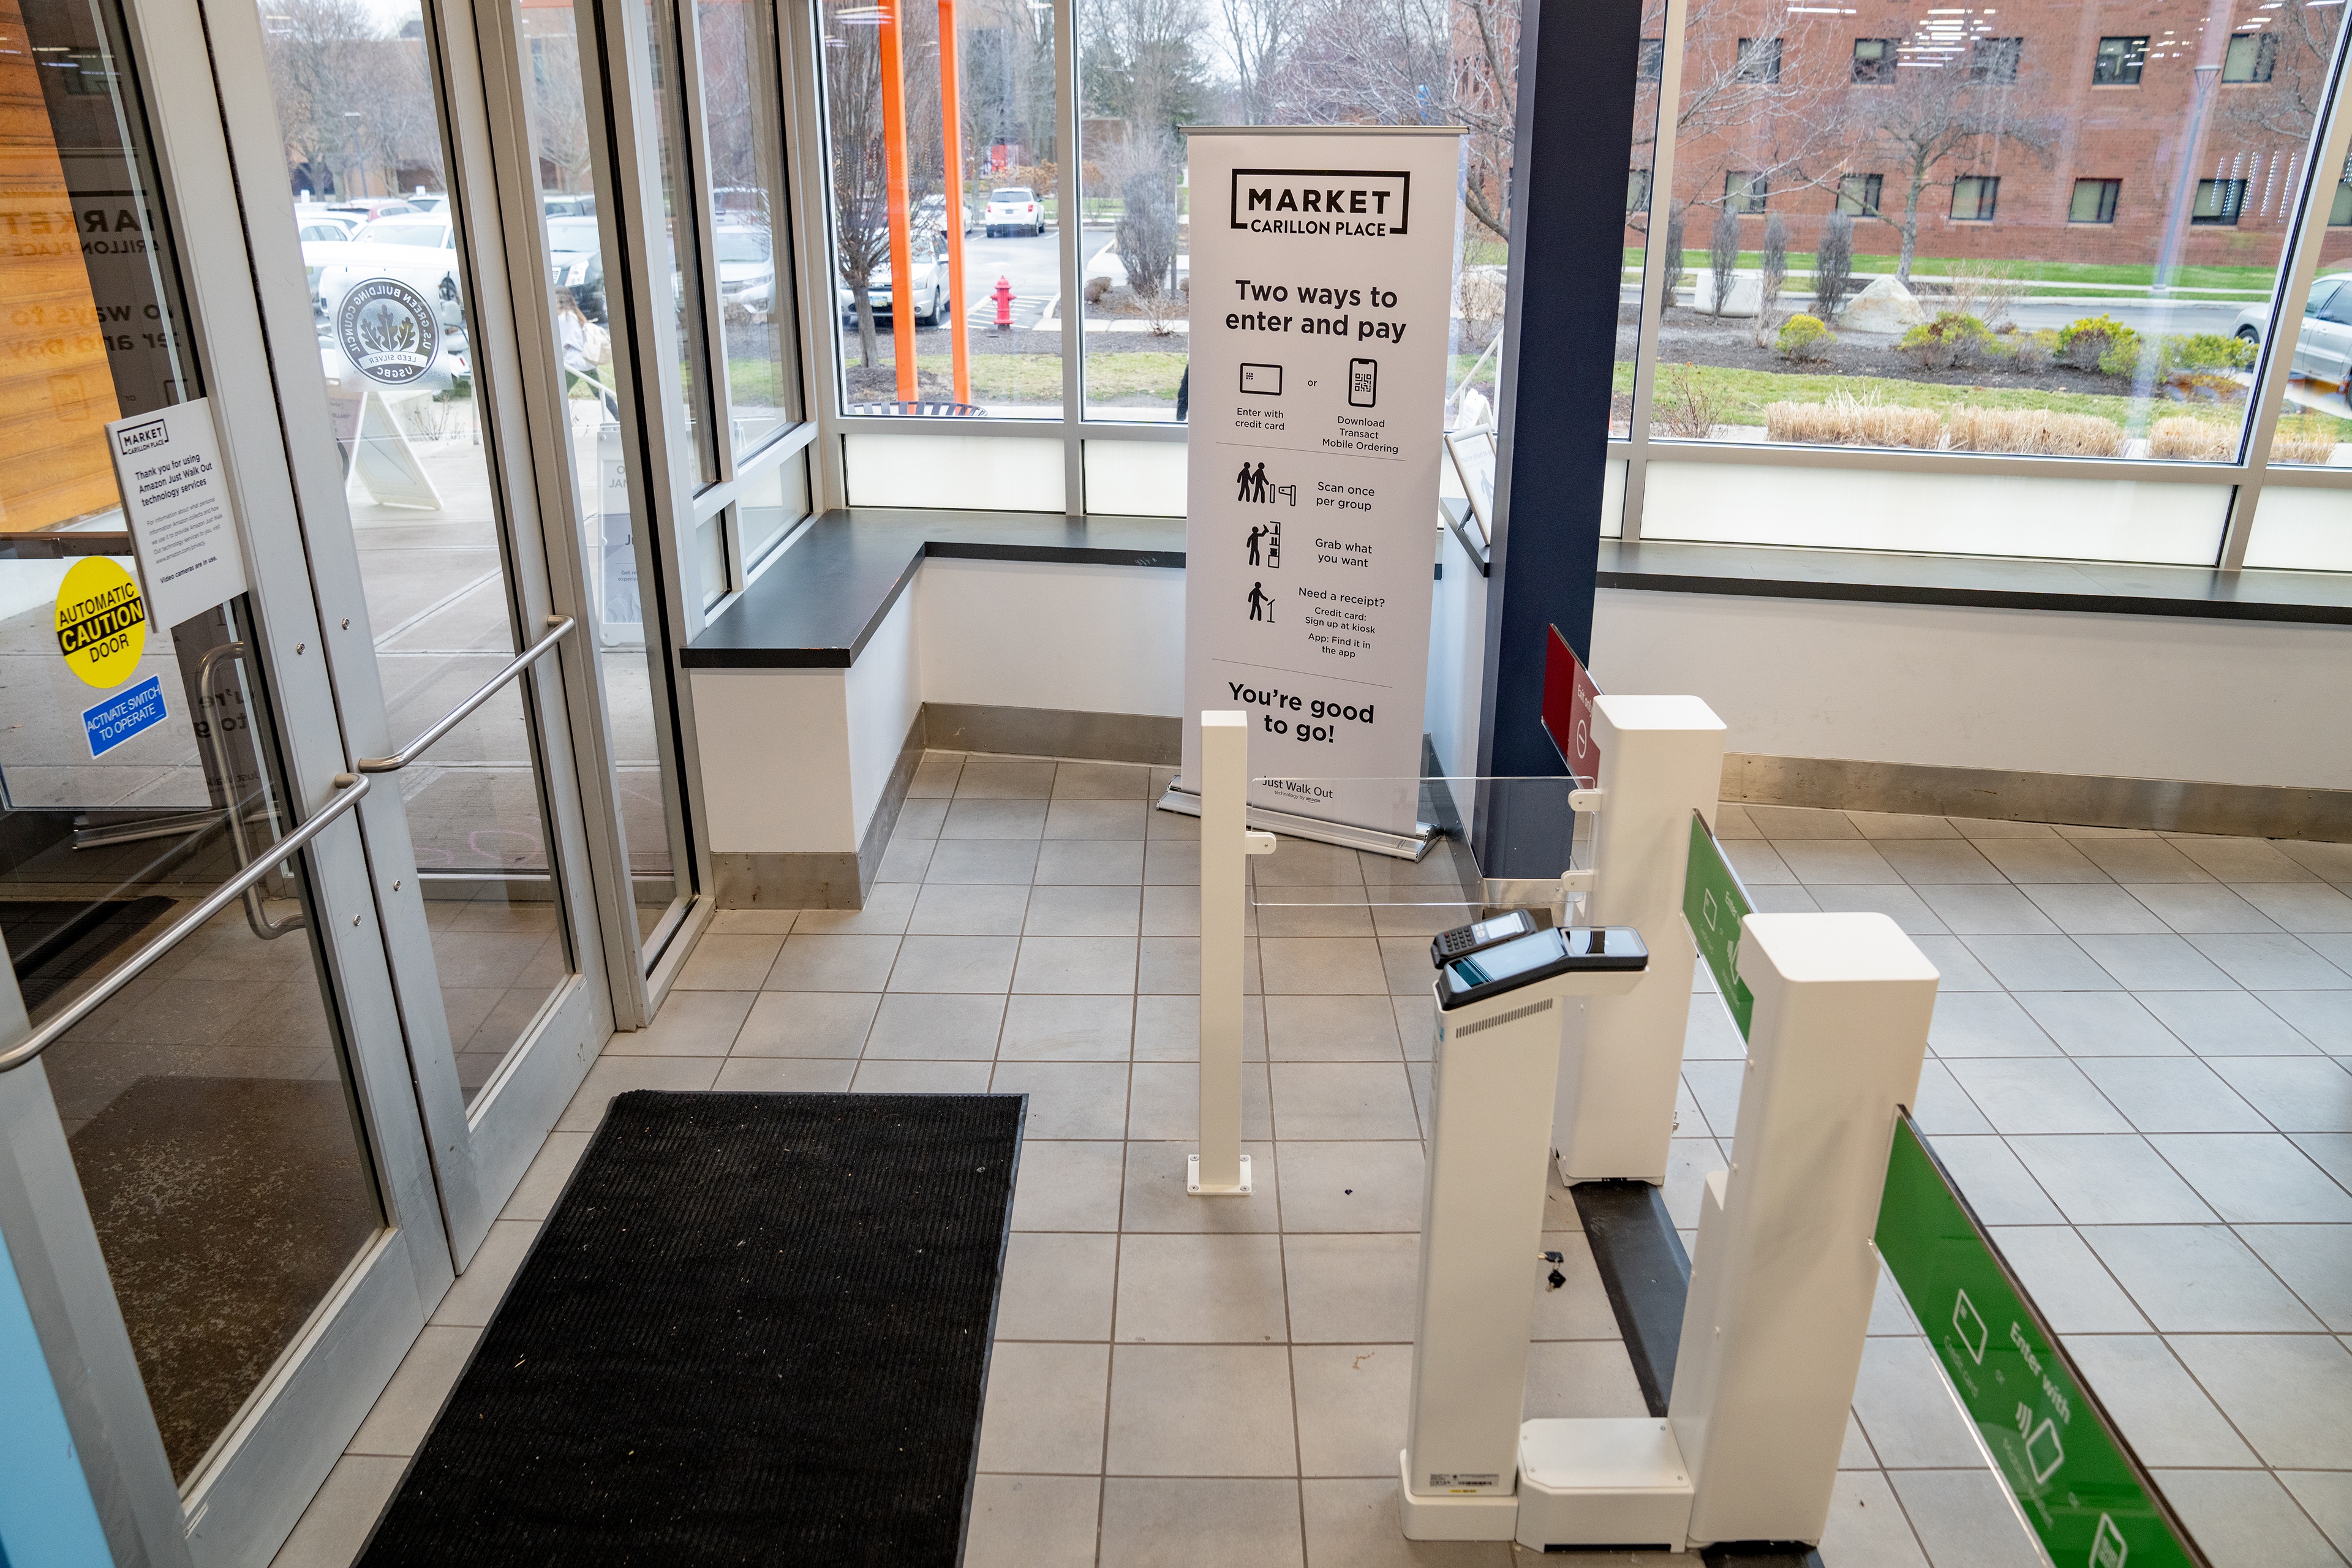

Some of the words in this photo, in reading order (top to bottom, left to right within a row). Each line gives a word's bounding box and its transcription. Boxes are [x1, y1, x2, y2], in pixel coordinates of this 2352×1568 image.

[1248, 188, 1390, 214] MARKET
[1251, 219, 1330, 235] CARILLON
[1335, 222, 1386, 237] PLACE
[1235, 279, 1288, 302] Two
[1297, 287, 1361, 310] ways
[1370, 287, 1398, 308] to
[1226, 311, 1293, 333] enter
[1301, 314, 1349, 336] and
[1358, 320, 1407, 344] pay
[1237, 407, 1262, 417] Enter
[1264, 409, 1284, 418] with
[1337, 416, 1385, 428] Download
[1235, 419, 1262, 429] credit
[1264, 422, 1285, 431] card
[1340, 428, 1379, 439] Transact
[124, 427, 162, 447] MARKET
[1322, 438, 1353, 449] Mobile
[1355, 442, 1399, 454] Ordering
[128, 443, 151, 455] CARILLON
[151, 439, 165, 448] PLACE
[135, 469, 157, 481] Thank
[158, 463, 170, 475] you
[172, 459, 181, 469] for
[183, 454, 200, 466] using
[140, 479, 167, 494] Amazon
[168, 473, 182, 484] Just
[183, 467, 200, 479] Walk
[200, 462, 213, 472] Out
[141, 486, 179, 507] technology
[181, 478, 206, 493] services
[1317, 481, 1344, 493] Scan
[1348, 486, 1375, 497] once
[155, 511, 178, 523] information
[200, 497, 216, 507] personal
[1316, 497, 1335, 507] per
[1338, 500, 1371, 512] group
[149, 524, 172, 536] information
[173, 517, 188, 526] Amazon
[190, 521, 205, 530] Amazon
[162, 540, 184, 552] technology
[184, 533, 200, 543] services
[1315, 538, 1341, 550] Grab
[1345, 543, 1373, 554] what
[1317, 554, 1338, 564] you
[1341, 557, 1368, 568] want
[160, 575, 175, 584] Video
[175, 565, 194, 578] cameras
[59, 582, 134, 627] AUTOMATIC
[1298, 587, 1327, 600] Need
[1340, 594, 1385, 608] receipt?
[1314, 607, 1342, 617] Credit
[1344, 612, 1366, 621] card:
[62, 600, 144, 652] CAUTION
[1305, 616, 1324, 627] Sign
[1352, 623, 1376, 634] kiosk
[89, 633, 129, 663] DOOR
[1308, 633, 1329, 643] App:
[1332, 636, 1351, 646] Find
[1363, 641, 1371, 649] in
[1338, 650, 1355, 658] app
[86, 702, 127, 733] ACTIVATE
[128, 684, 162, 711] SWITCH
[1228, 681, 1302, 711] You’re
[1311, 699, 1374, 724] good
[99, 726, 113, 742] TO
[115, 703, 156, 734] OPERATE
[1264, 714, 1287, 734] to
[1296, 723, 1334, 744] go!
[1262, 775, 1283, 789] Just
[1286, 781, 1311, 794] Walk
[1313, 787, 1333, 799] Out
[1275, 790, 1298, 799] technology
[2010, 1321, 2043, 1377] Enter
[2043, 1374, 2071, 1425] with
